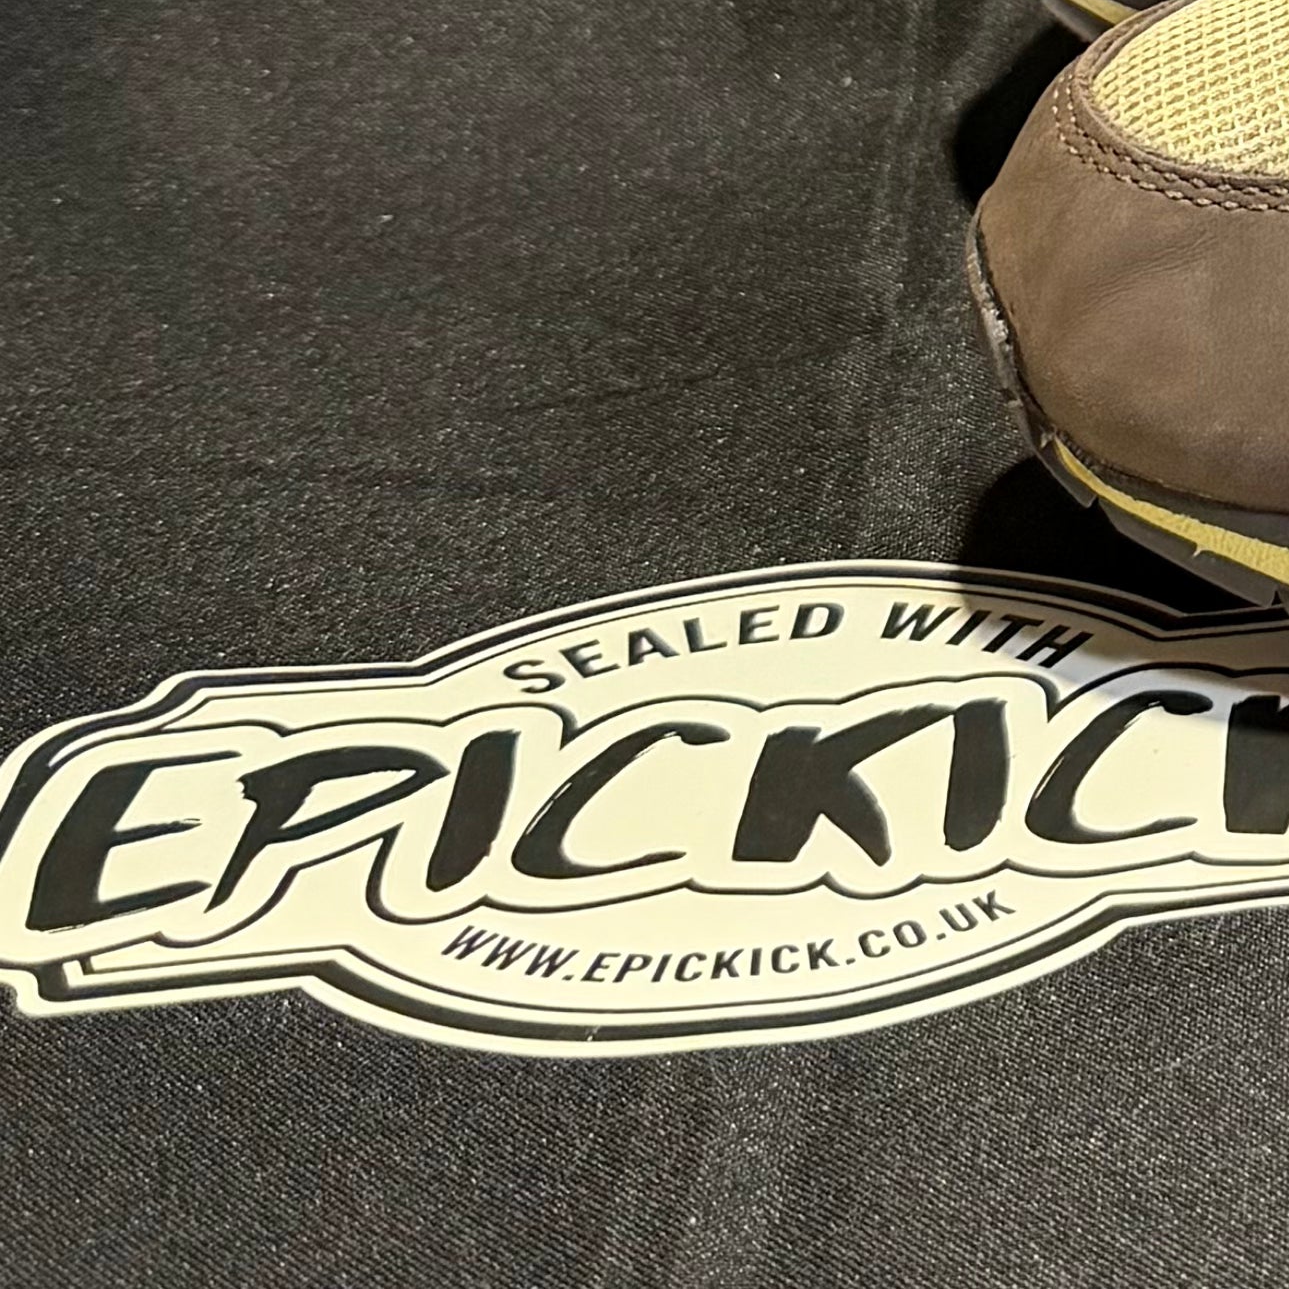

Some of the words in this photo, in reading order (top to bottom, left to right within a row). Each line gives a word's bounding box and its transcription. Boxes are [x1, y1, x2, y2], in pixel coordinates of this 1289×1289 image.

[502, 601, 846, 695] SEALED
[880, 600, 1093, 669] WITH
[441, 890, 1017, 984] WWW.EPICKICK.CO.UK
